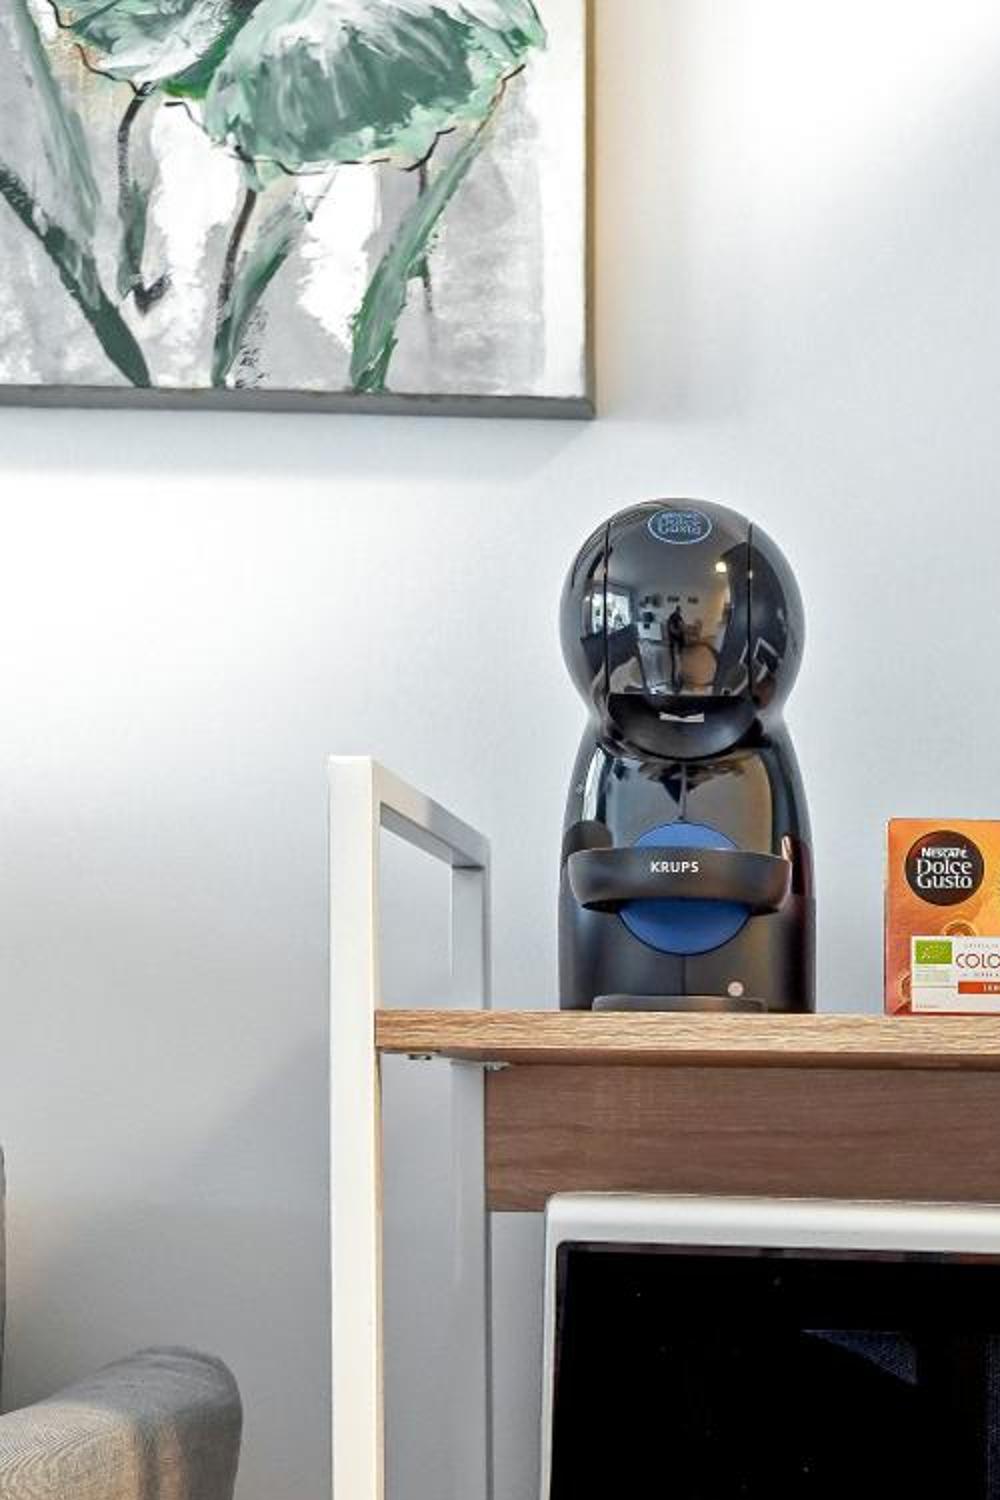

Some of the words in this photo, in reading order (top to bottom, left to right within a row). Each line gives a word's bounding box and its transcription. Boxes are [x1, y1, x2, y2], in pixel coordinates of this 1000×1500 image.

[650, 861, 699, 873] KRUPS
[917, 859, 973, 875] Dolce
[917, 874, 973, 889] Gusto
